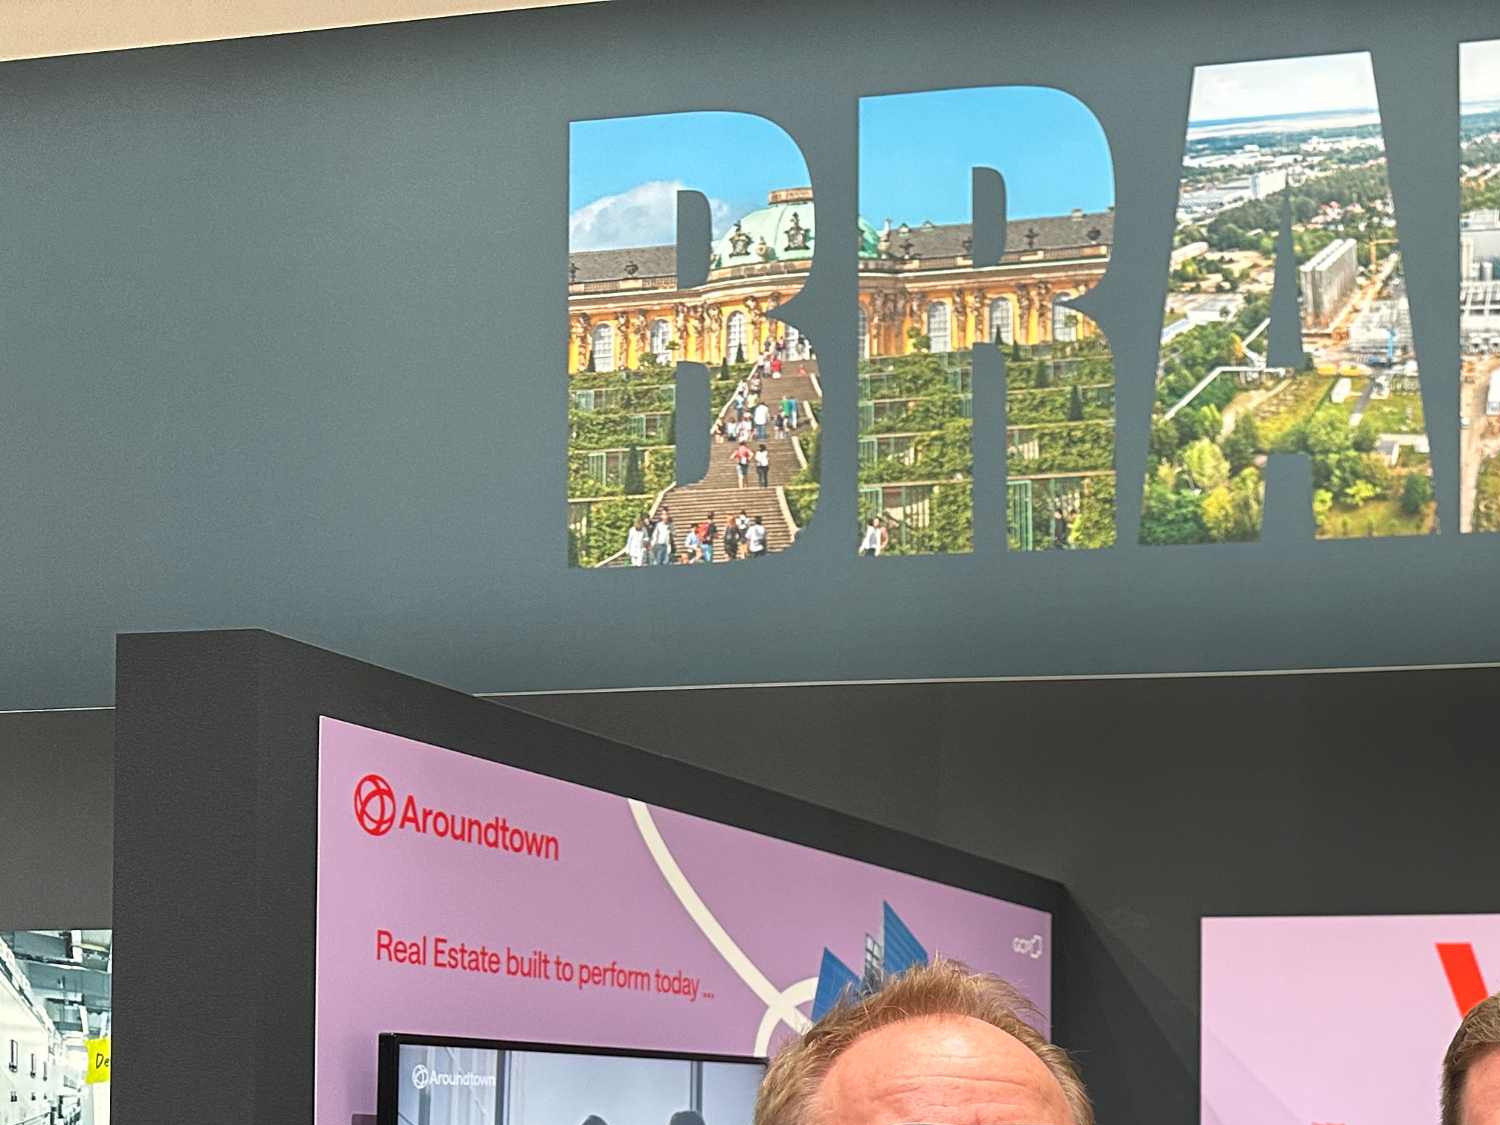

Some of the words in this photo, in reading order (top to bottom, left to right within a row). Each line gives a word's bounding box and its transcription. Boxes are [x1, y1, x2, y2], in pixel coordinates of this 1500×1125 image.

[399, 795, 560, 862] Aroundtown
[376, 929, 427, 967] Real
[433, 937, 500, 976] Estate
[506, 947, 550, 981] built
[554, 955, 574, 983] to
[578, 961, 651, 991] perform
[655, 969, 700, 1002] today
[428, 1069, 497, 1088] Aroundtown
